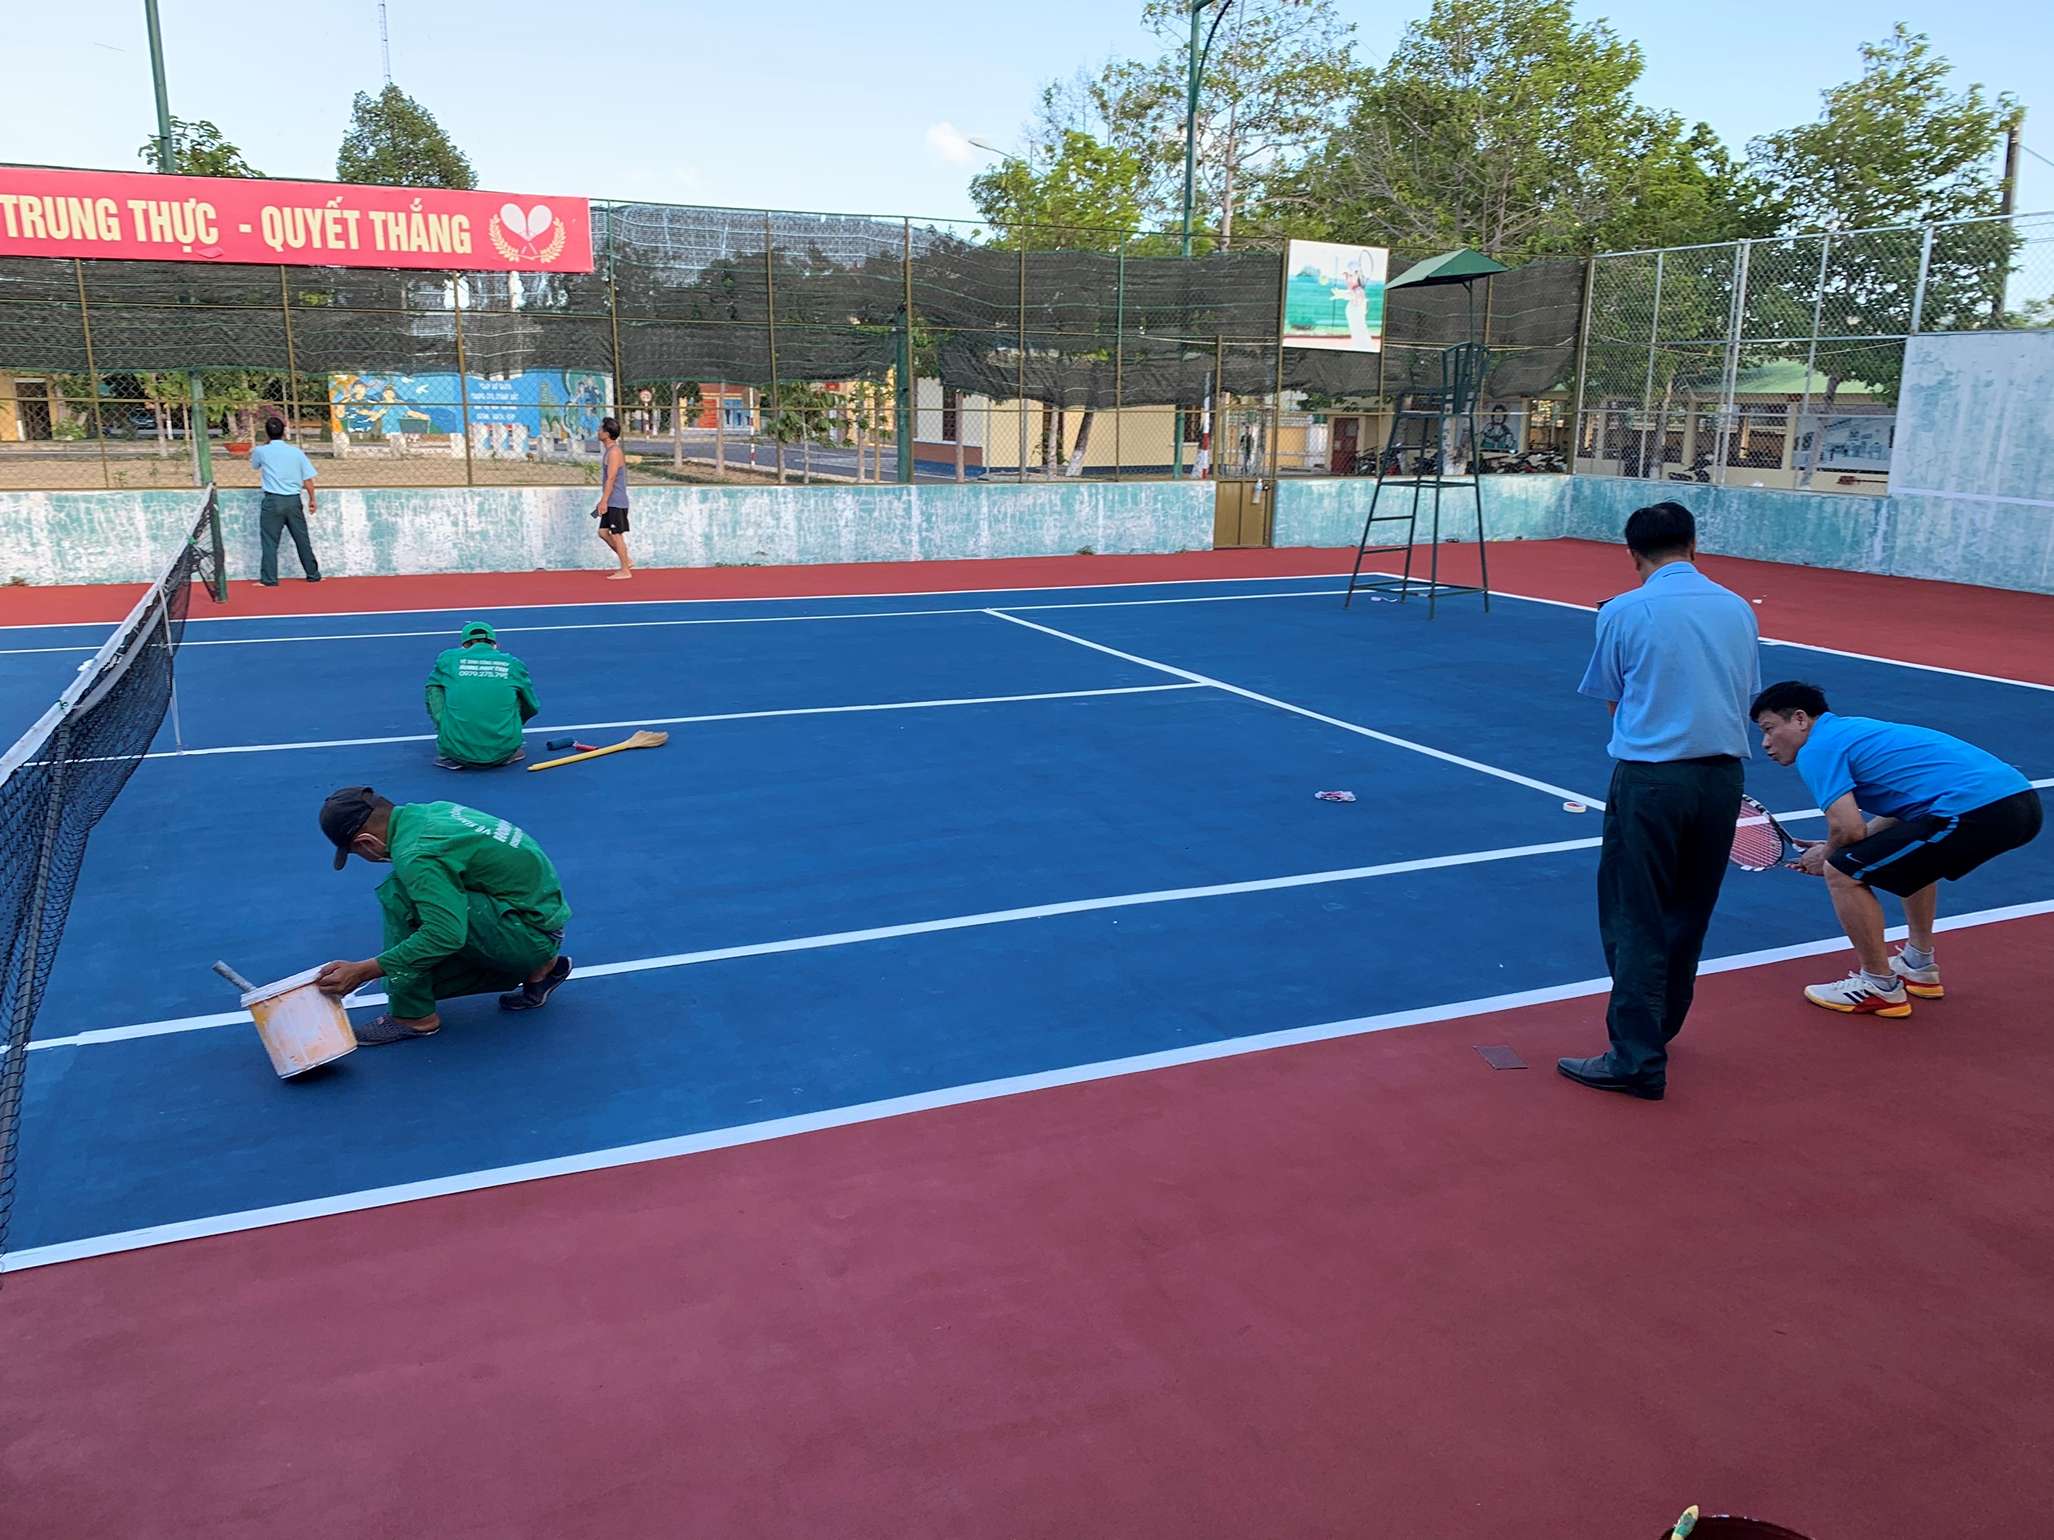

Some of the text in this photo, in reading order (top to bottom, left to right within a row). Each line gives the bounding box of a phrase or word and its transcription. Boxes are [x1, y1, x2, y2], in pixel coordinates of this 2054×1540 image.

[0, 194, 121, 241] TRUNG
[127, 198, 219, 253] THỰC
[260, 196, 361, 252] QUYẾT
[368, 197, 473, 254] THẮNG
